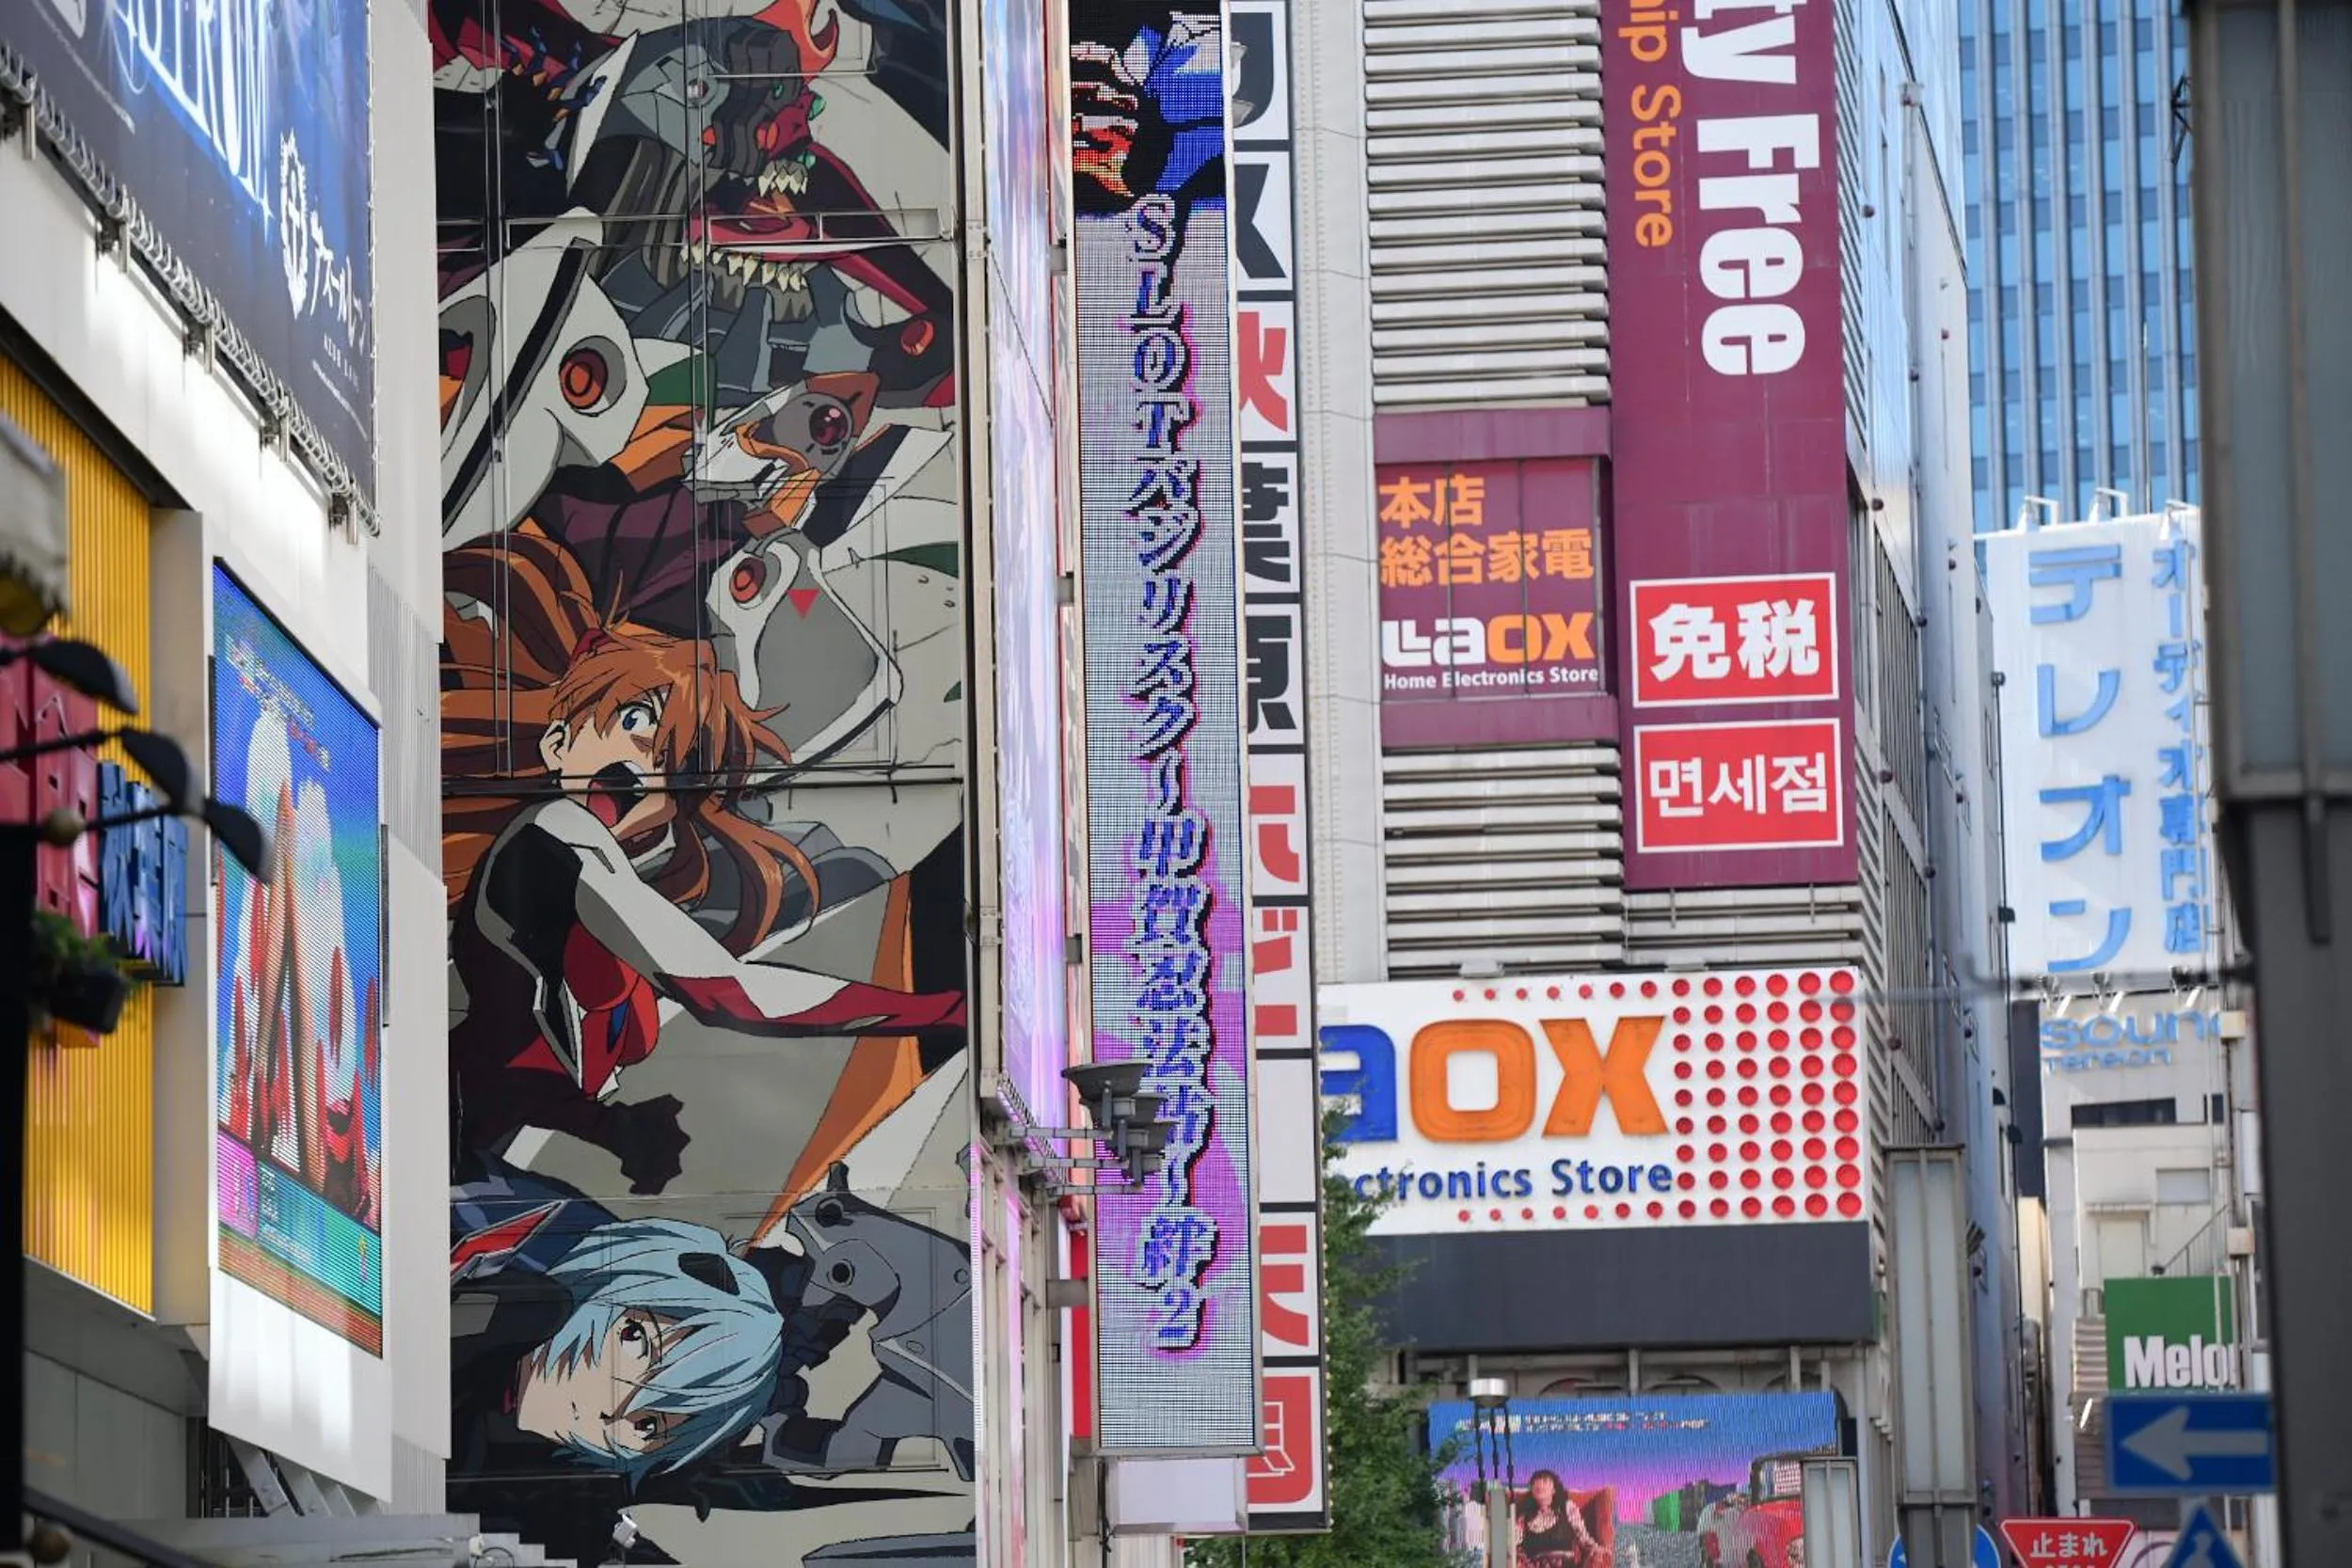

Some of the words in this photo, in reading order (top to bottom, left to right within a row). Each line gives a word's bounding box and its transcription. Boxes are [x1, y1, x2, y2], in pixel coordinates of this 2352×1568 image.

[1629, 84, 1681, 247] Store
[1696, 113, 1820, 376] Free
[1379, 474, 1485, 529] 本店
[1380, 528, 1594, 587] 総合家電
[1649, 599, 1820, 682] 免税
[1384, 673, 1437, 690] Home
[1442, 667, 1545, 688] Electronics
[1549, 665, 1598, 682] Store
[1649, 752, 1828, 817] 면세점
[2028, 543, 2132, 973] テレオン
[2040, 1008, 2221, 1050] soun
[1550, 1157, 1673, 1197] Store
[2030, 1530, 2107, 1559] 止まれ
